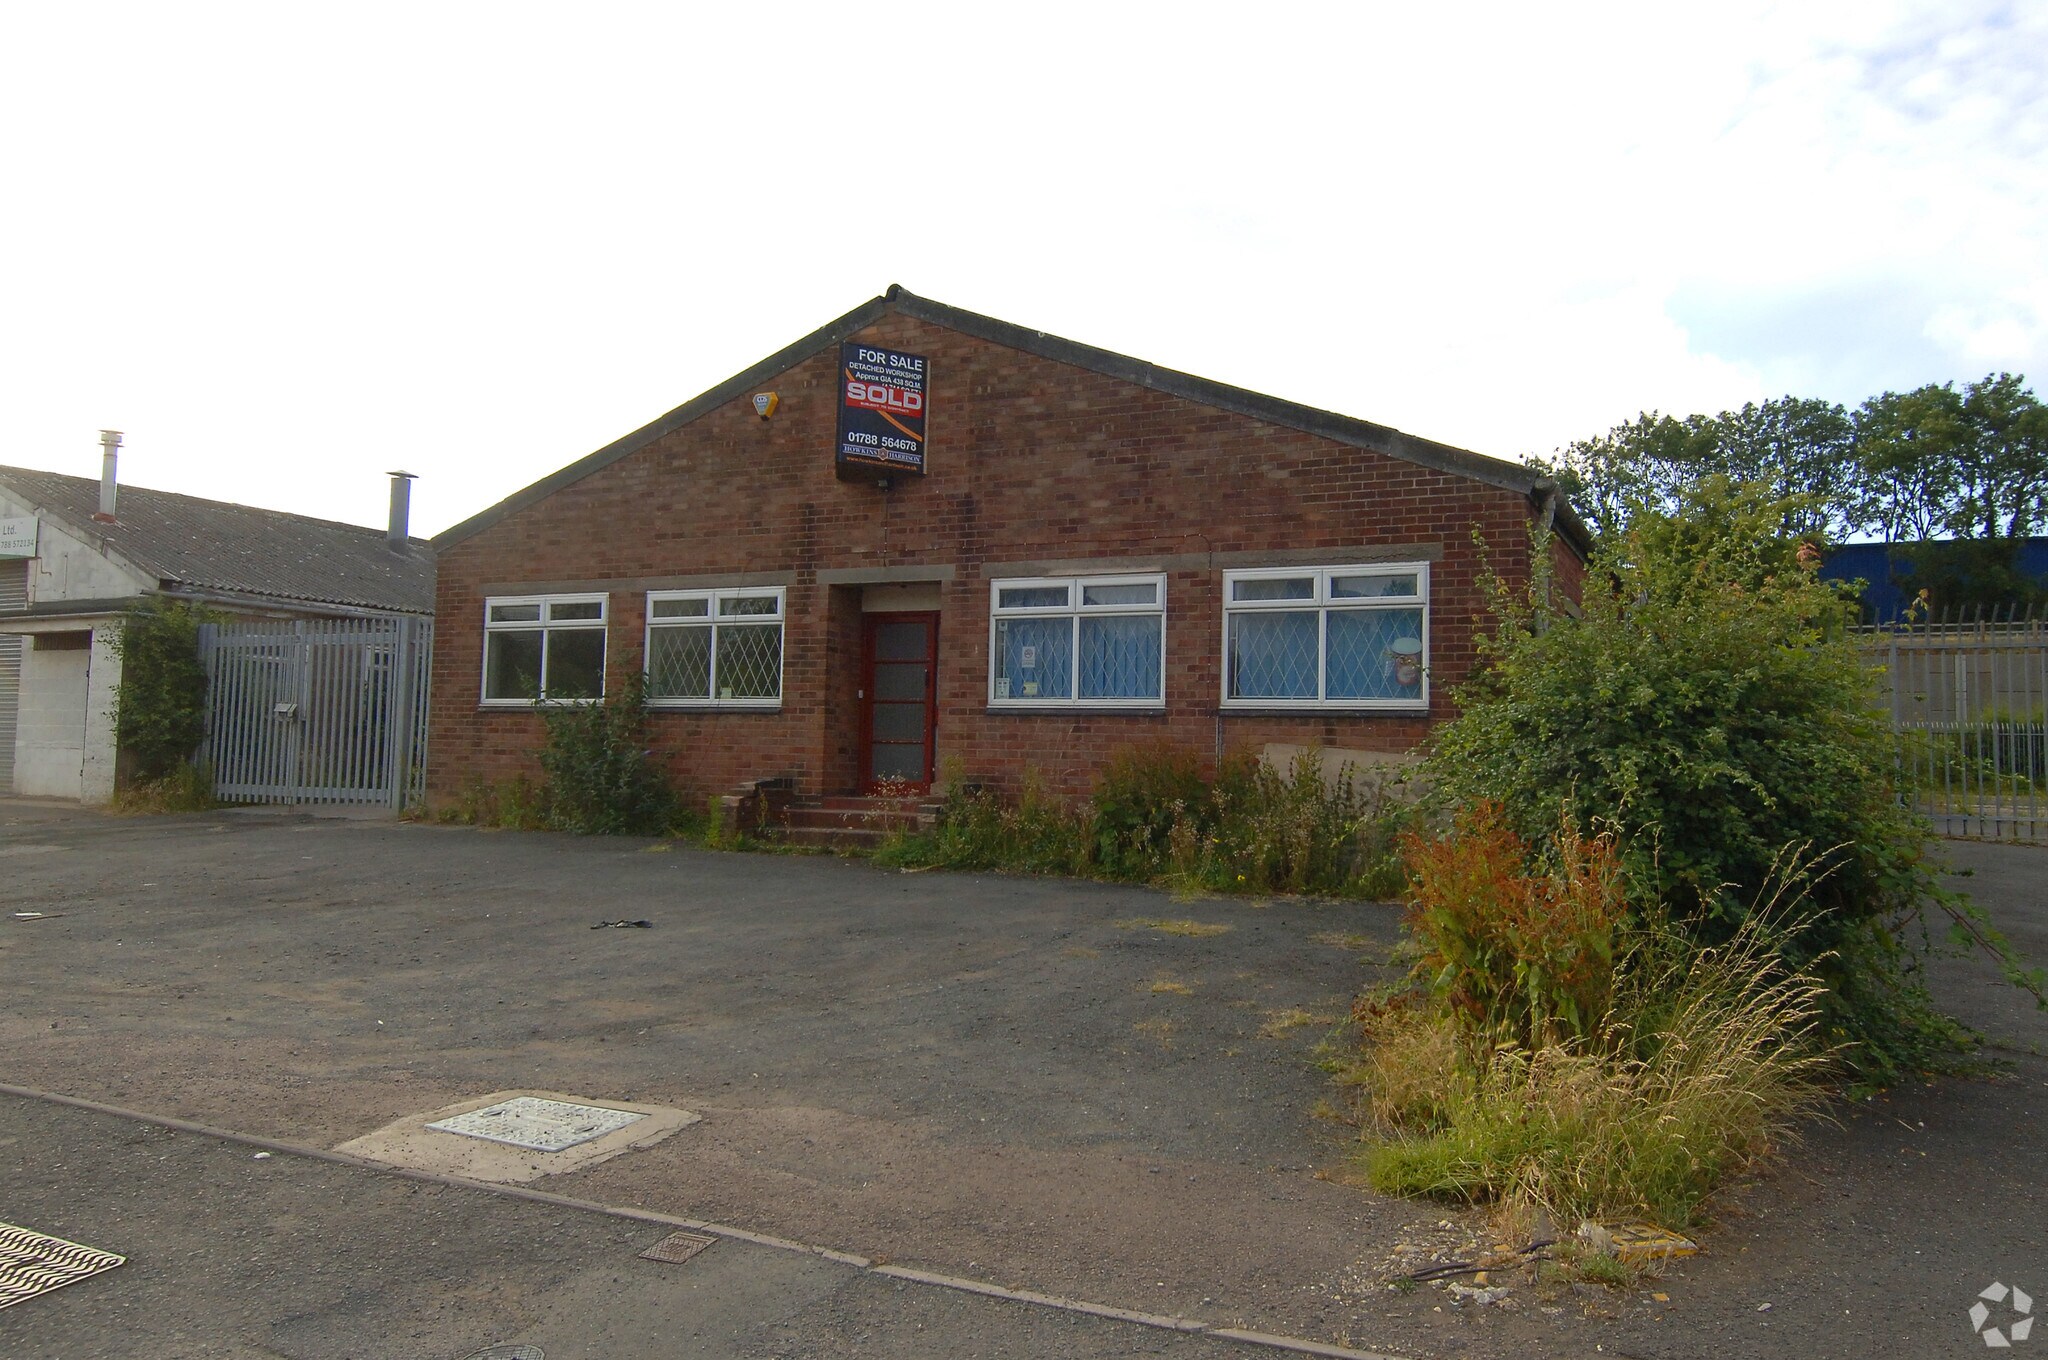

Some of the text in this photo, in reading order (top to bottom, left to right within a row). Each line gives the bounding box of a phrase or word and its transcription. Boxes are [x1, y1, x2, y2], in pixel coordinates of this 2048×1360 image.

[859, 349, 923, 371] FOR SALE
[849, 361, 922, 380] DETACHED WORKSHOP
[855, 372, 879, 382] Approx
[847, 382, 922, 410] SOLD
[844, 446, 878, 456] HOWKINS
[848, 432, 917, 451] 01788 564678
[3, 525, 17, 535] Ltd.
